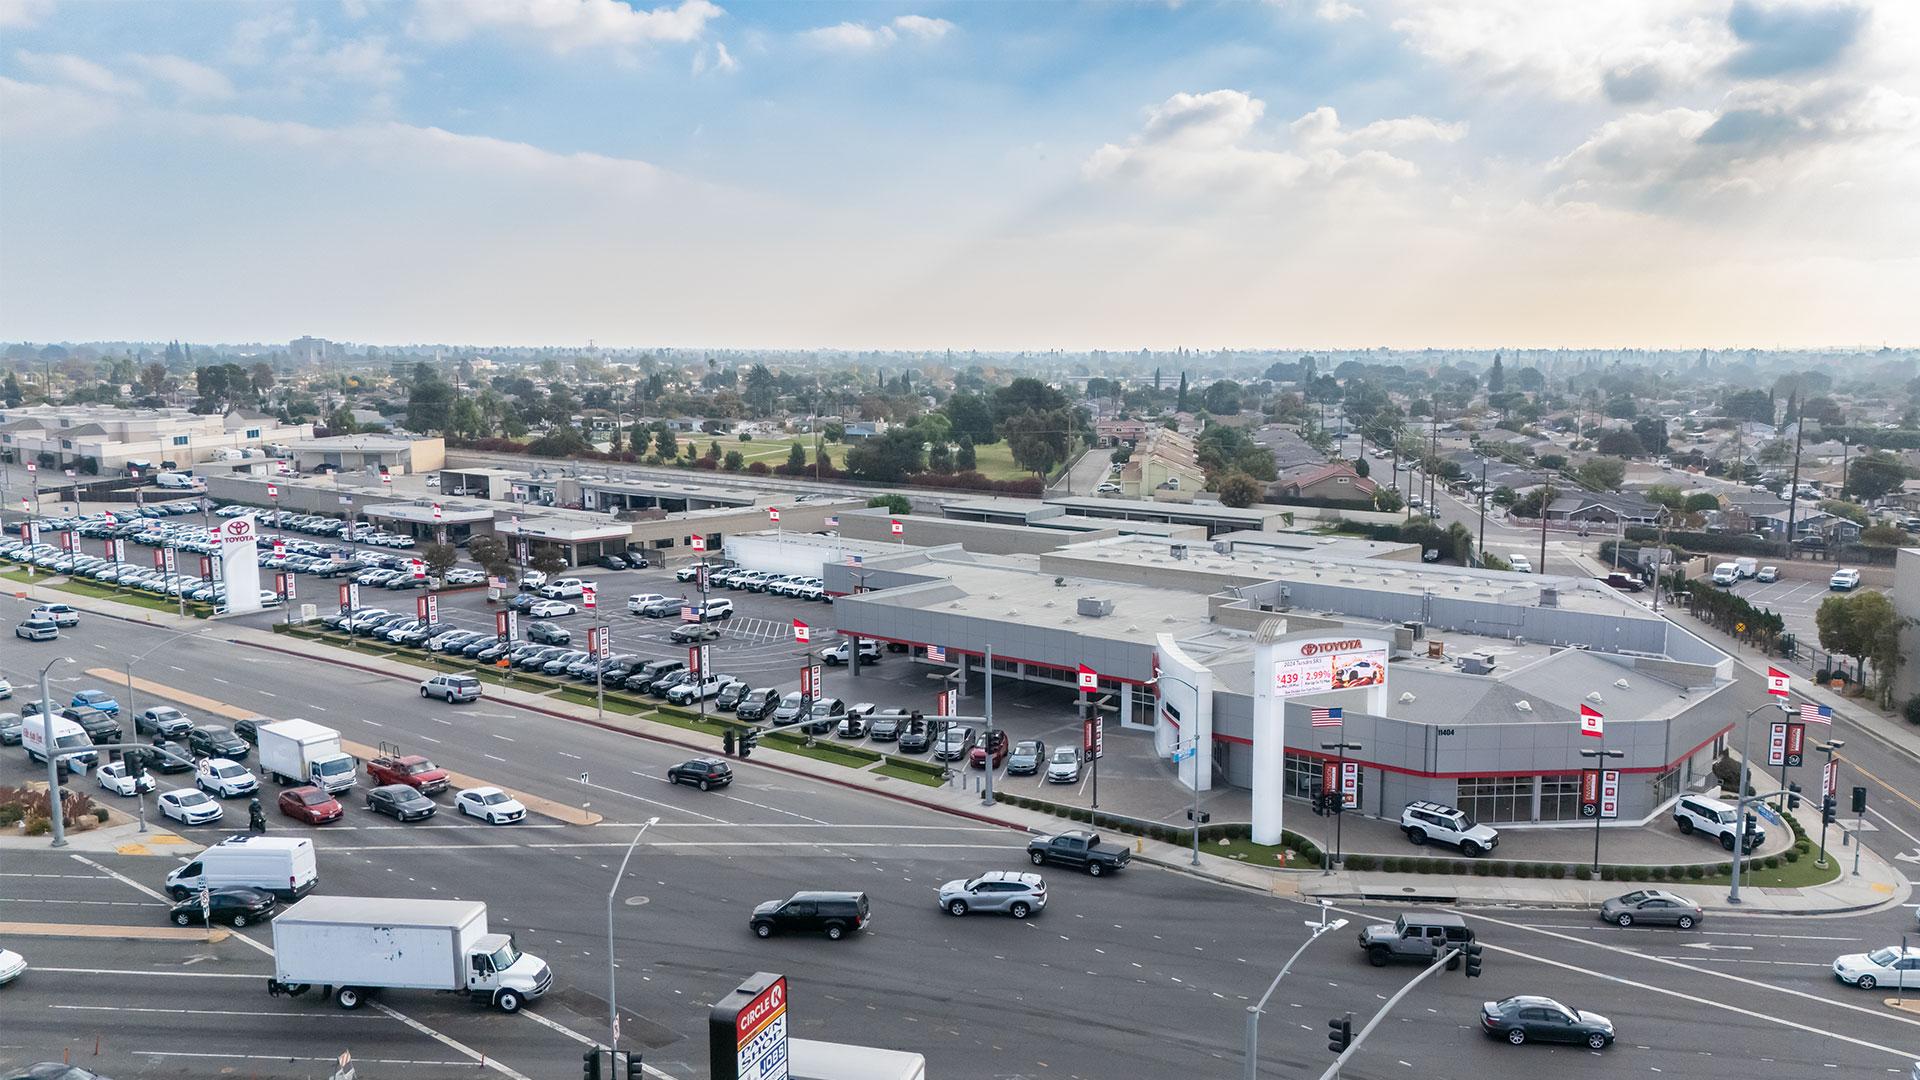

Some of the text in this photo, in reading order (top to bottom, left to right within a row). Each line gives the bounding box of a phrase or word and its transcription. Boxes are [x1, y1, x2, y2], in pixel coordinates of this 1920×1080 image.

[1318, 639, 1362, 653] TOYOTA
[1306, 669, 1331, 681] 2.99%
[741, 997, 770, 1030] CIRCLE
[741, 1018, 782, 1059] PAWN
[741, 1029, 782, 1069] SHOP
[761, 1045, 785, 1075] JOBS
